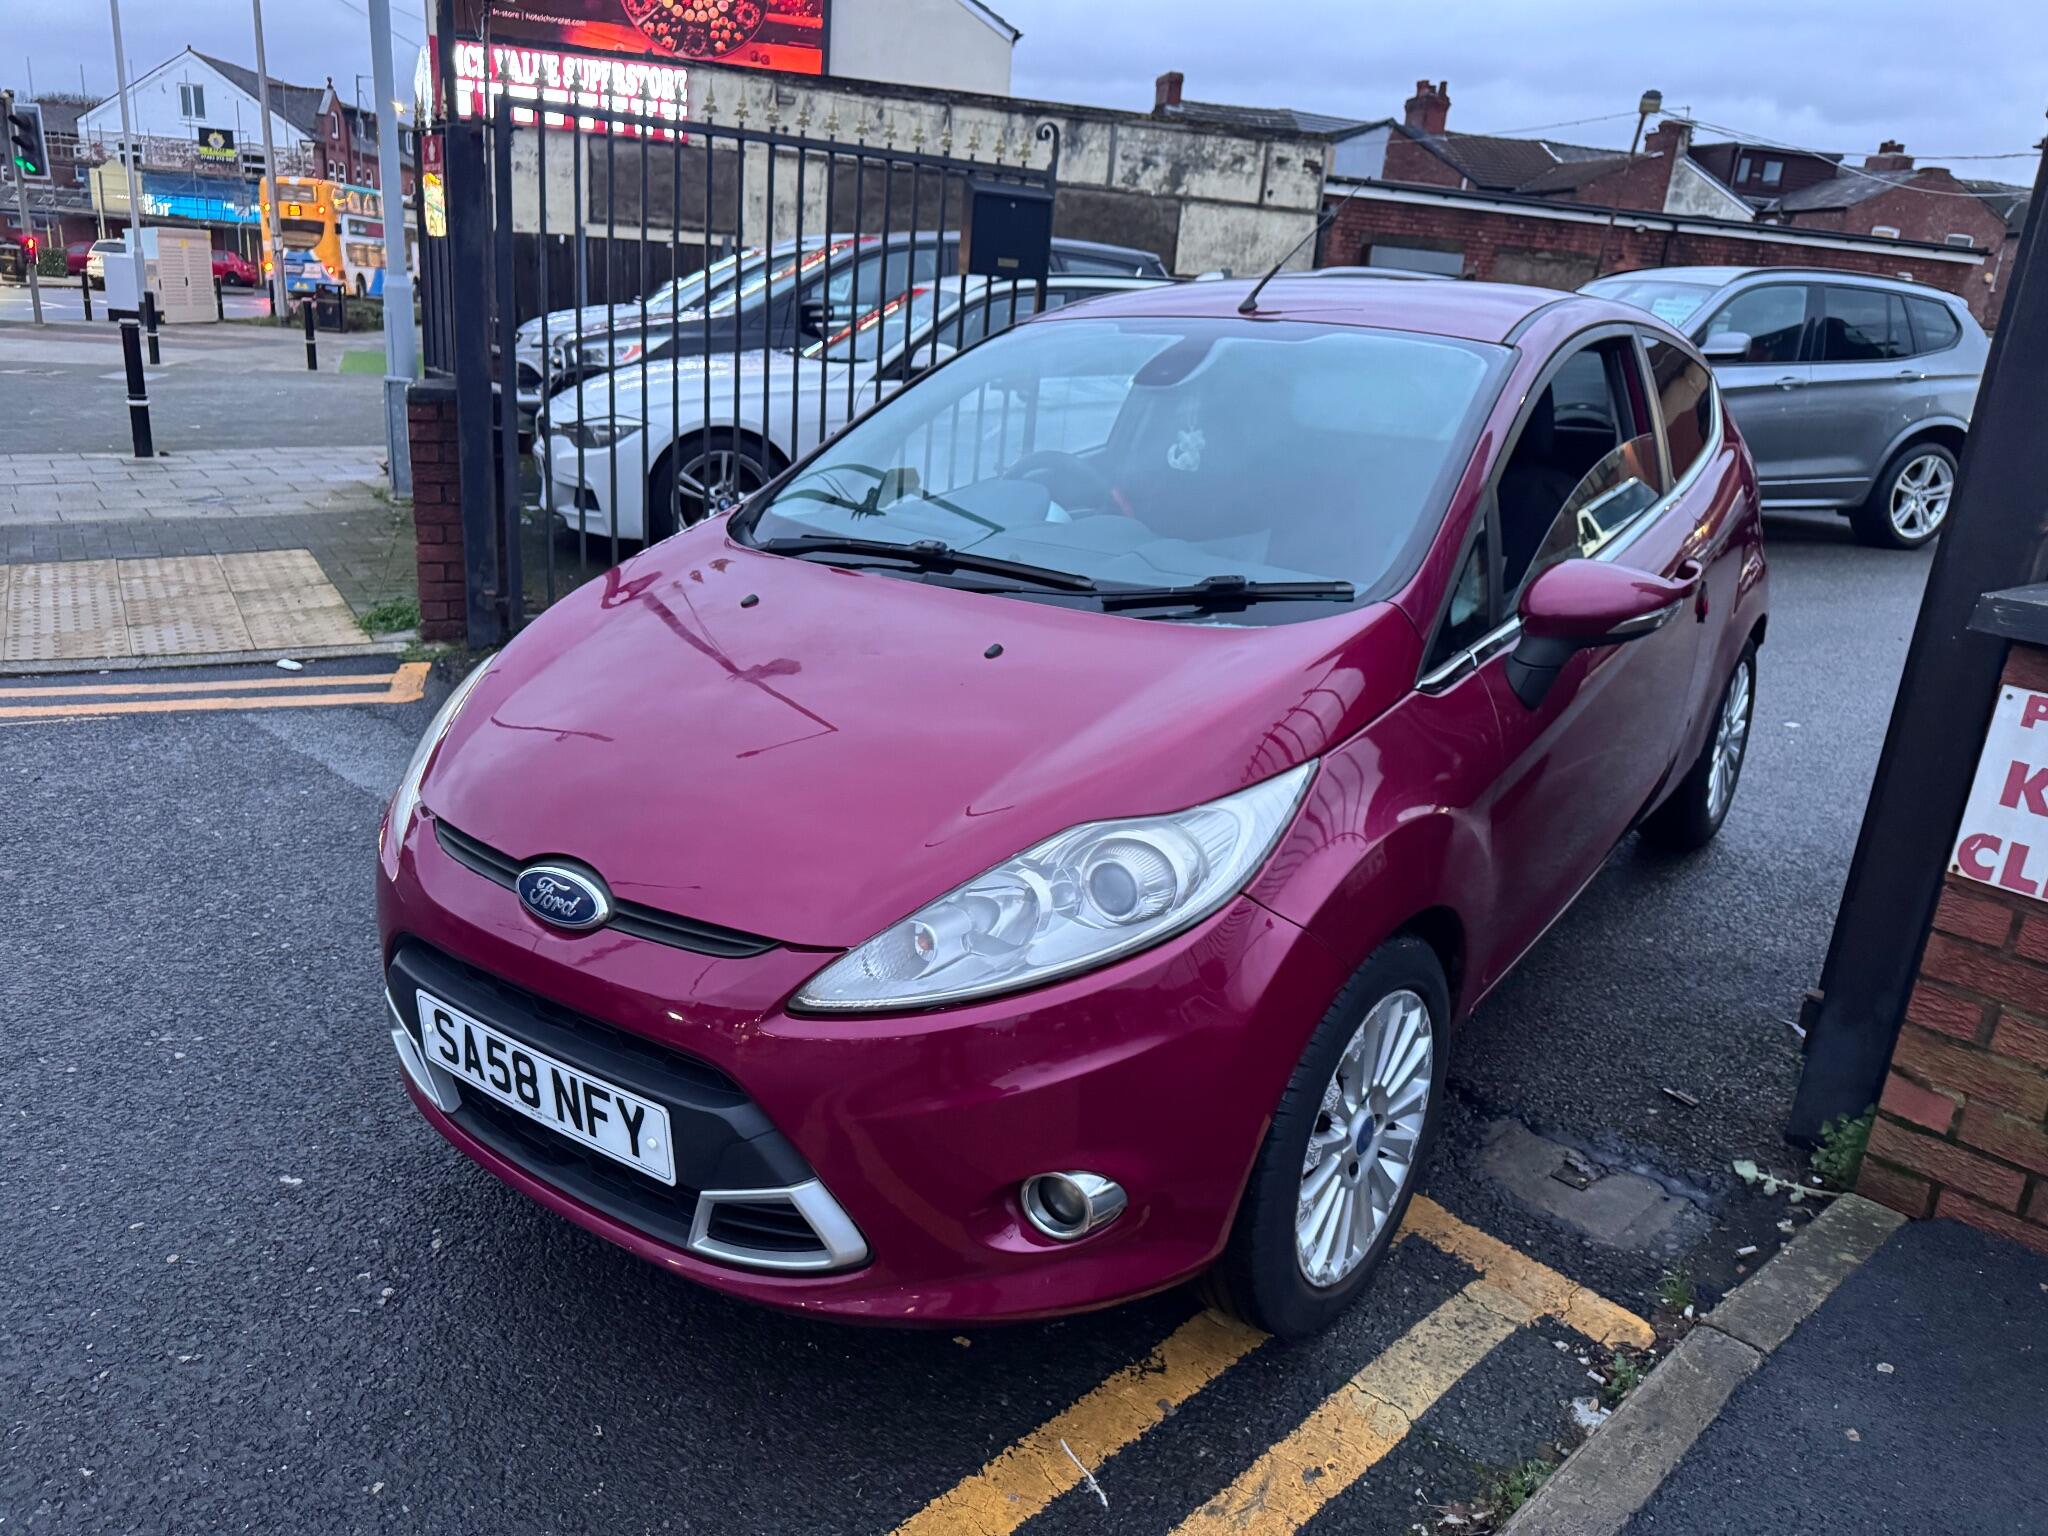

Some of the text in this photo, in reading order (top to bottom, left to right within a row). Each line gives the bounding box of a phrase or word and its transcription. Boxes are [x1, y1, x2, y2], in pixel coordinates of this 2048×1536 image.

[528, 877, 579, 917] Ford
[434, 1008, 645, 1158] SA58 NFY
